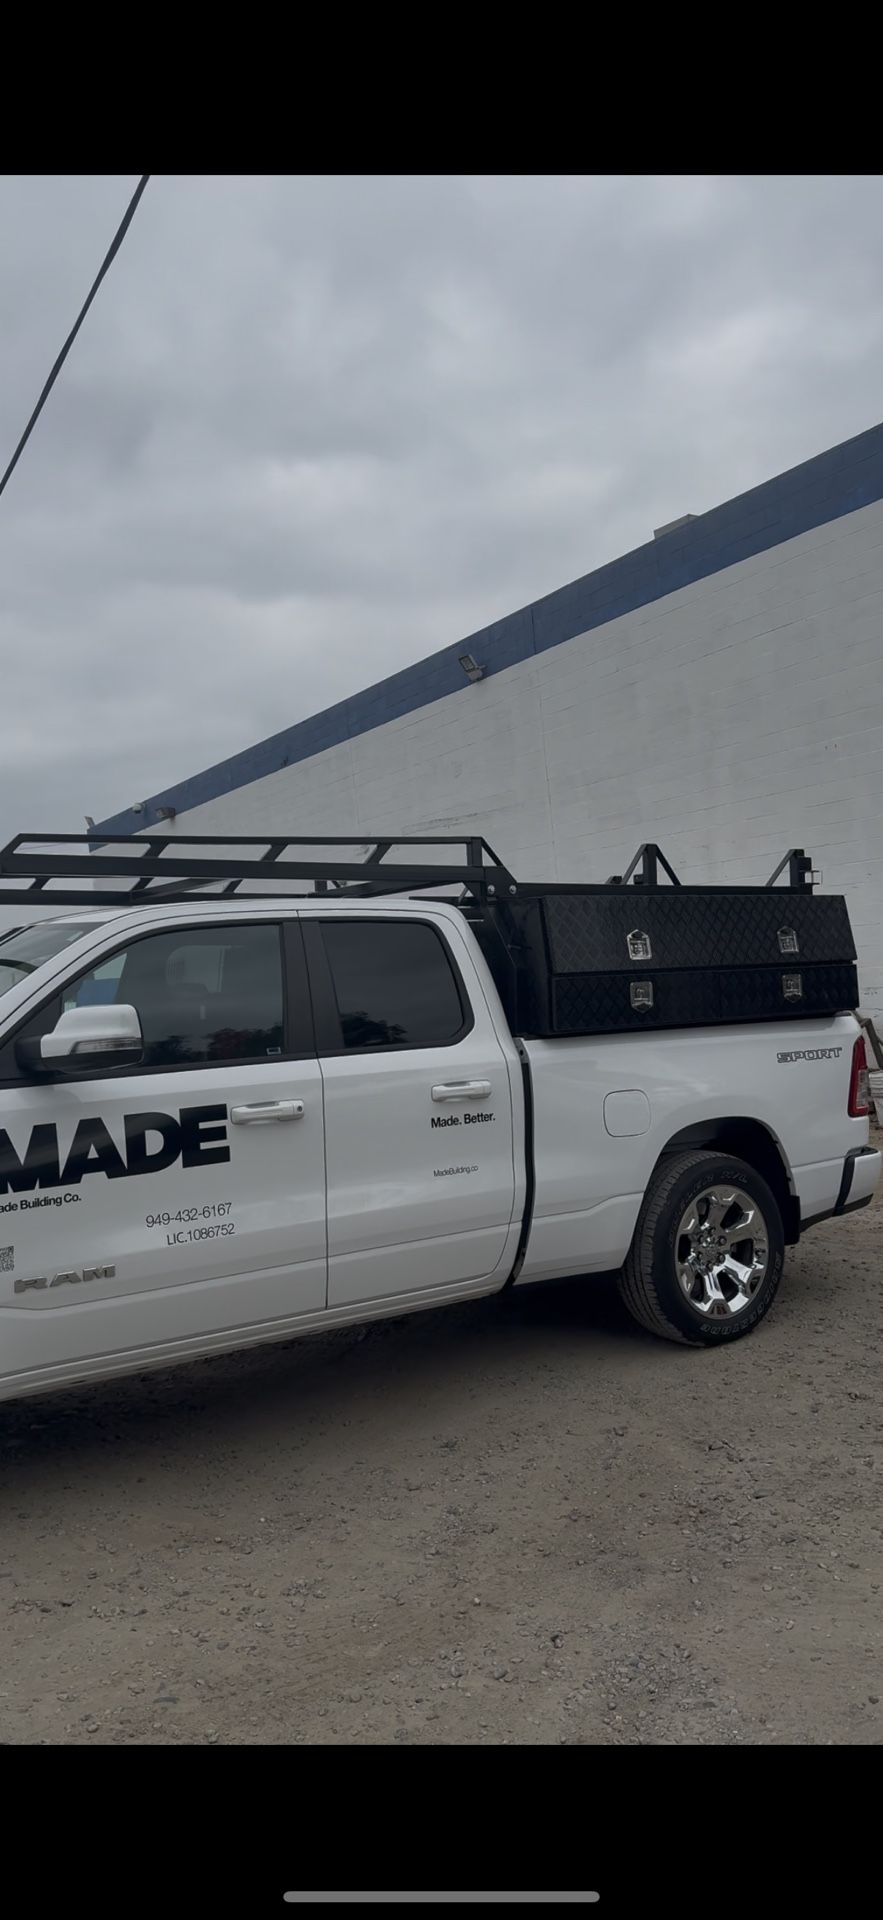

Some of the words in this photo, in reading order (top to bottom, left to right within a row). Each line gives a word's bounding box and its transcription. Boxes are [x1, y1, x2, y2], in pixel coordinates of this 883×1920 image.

[776, 1047, 842, 1062] SPORT
[431, 1116, 462, 1128] Made.
[464, 1112, 496, 1124] Better.
[0, 1103, 231, 1194] MADE
[433, 1166, 478, 1177] MadeBuilding.co
[20, 1196, 62, 1209] Building
[63, 1193, 82, 1204] Co.
[145, 1202, 233, 1228] 949-432-6167
[166, 1223, 236, 1246] LIC.1086752
[14, 1265, 116, 1293] RAM
